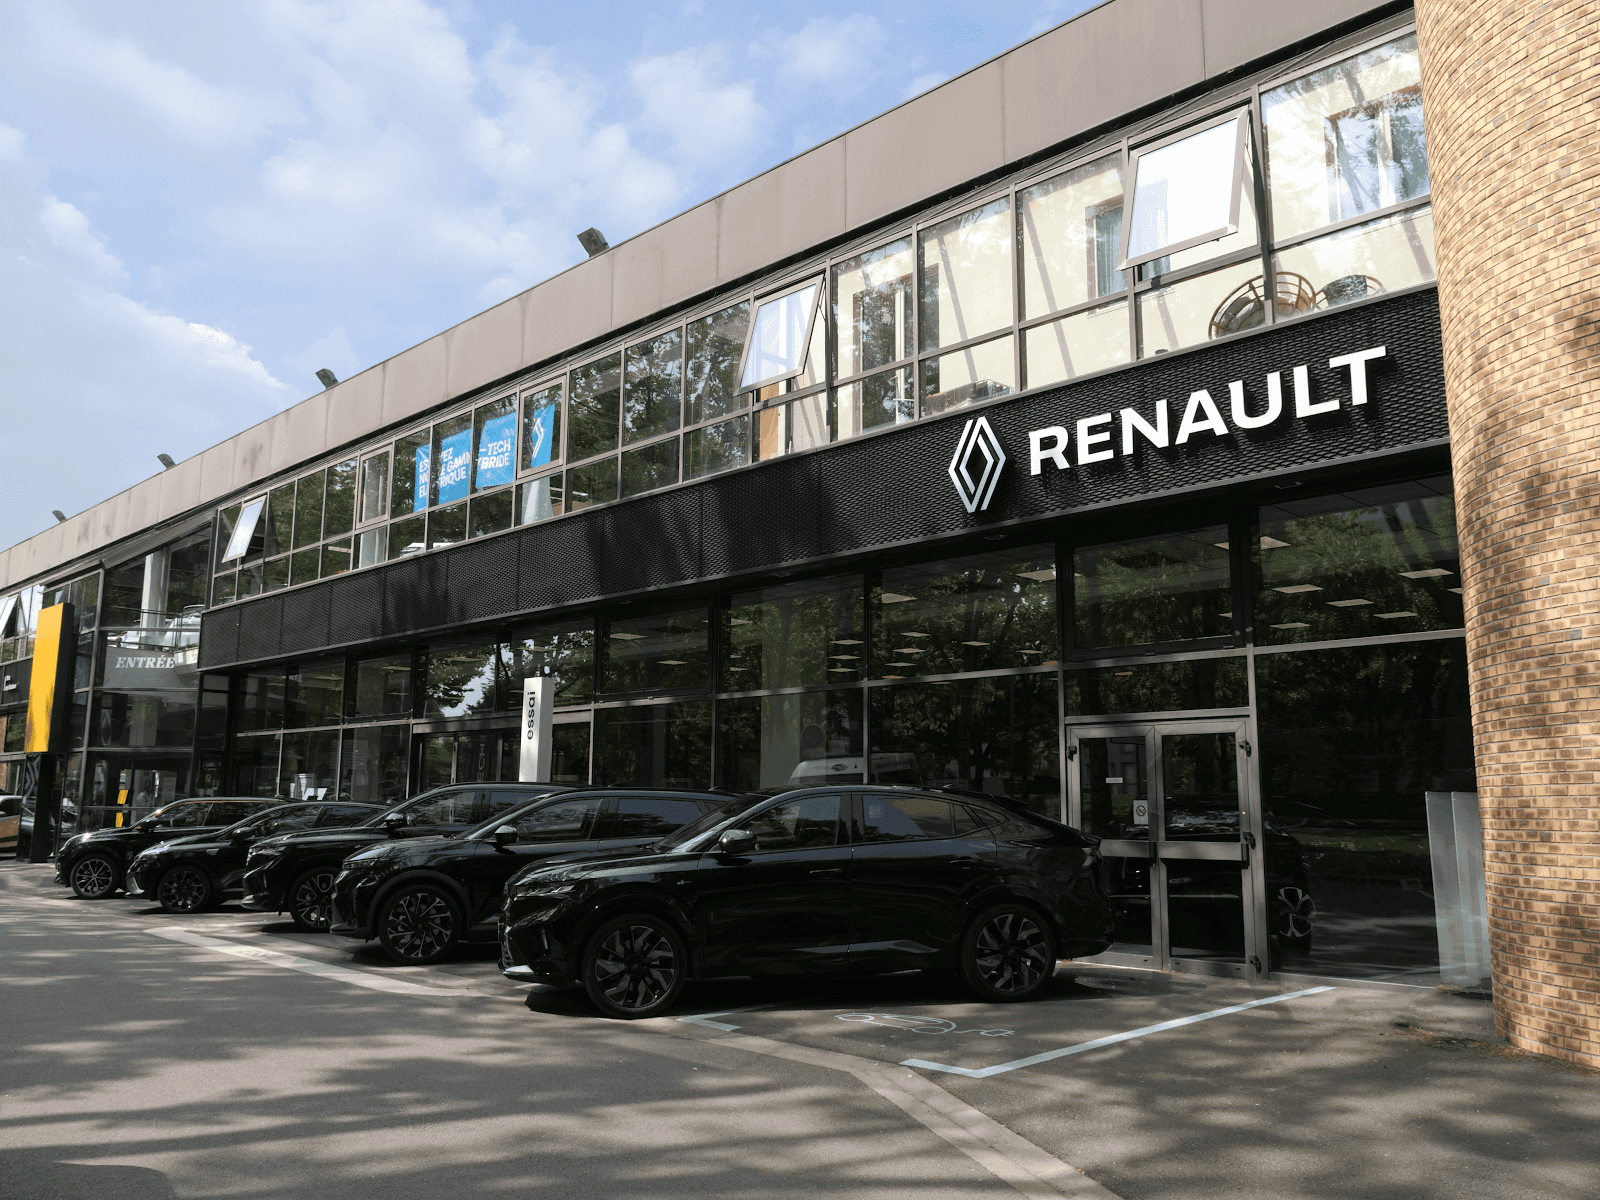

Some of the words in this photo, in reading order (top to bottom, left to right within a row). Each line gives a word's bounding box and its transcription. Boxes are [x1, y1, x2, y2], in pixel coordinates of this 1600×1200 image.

[1028, 346, 1387, 476] RENAULT
[447, 451, 471, 471] GAMM
[480, 438, 511, 456] -TECH
[115, 655, 176, 669] ENTRÉE
[527, 691, 536, 741] essai
